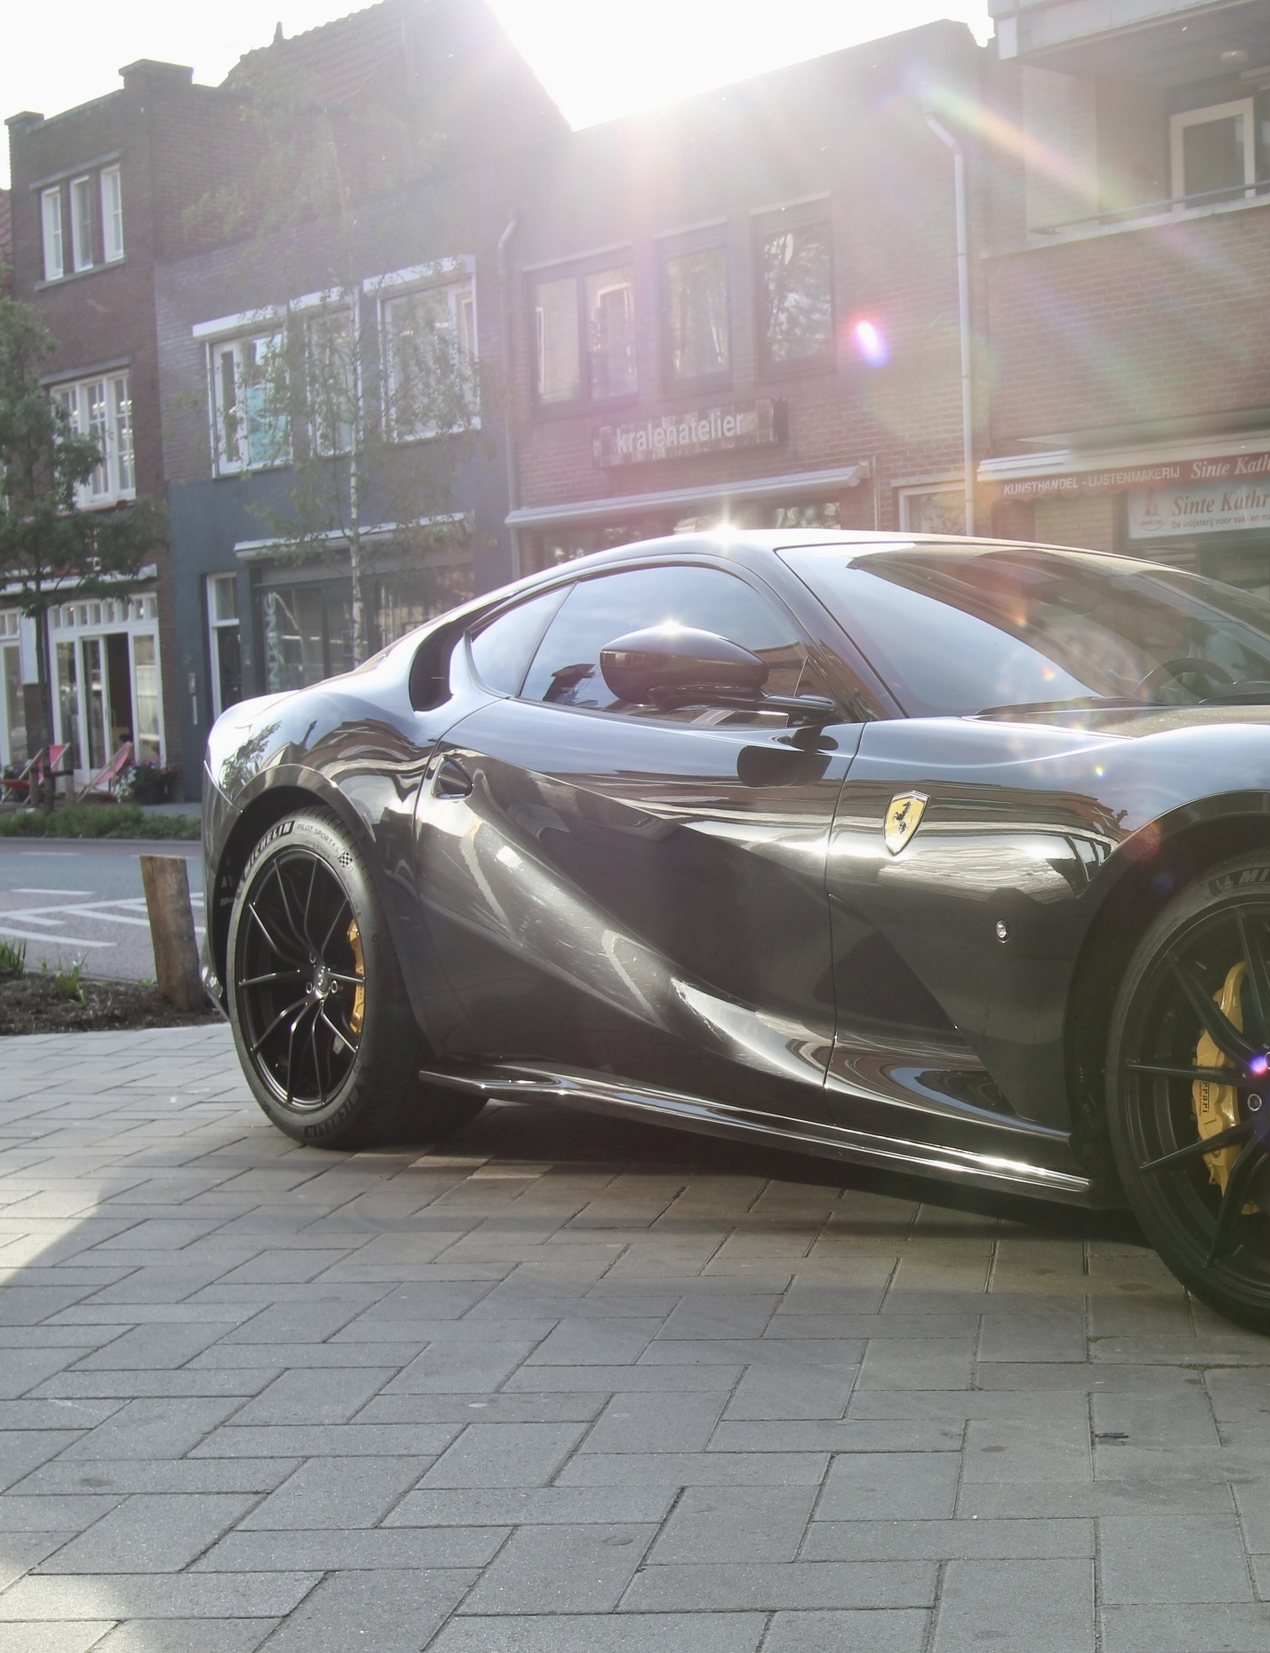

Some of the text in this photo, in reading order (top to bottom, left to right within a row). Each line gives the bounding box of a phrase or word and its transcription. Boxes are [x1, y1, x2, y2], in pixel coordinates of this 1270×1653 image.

[616, 411, 744, 454] kralenatelier
[1003, 477, 1079, 496] KUNSTHANDEL
[1087, 466, 1180, 488] LIJSTENMAKERIJ
[1190, 460, 1230, 480] Sinte
[1171, 495, 1215, 517] Sinte
[1215, 516, 1232, 525] voor
[1250, 513, 1261, 522] en
[297, 823, 314, 833] PILOT
[314, 827, 332, 845] SPORT
